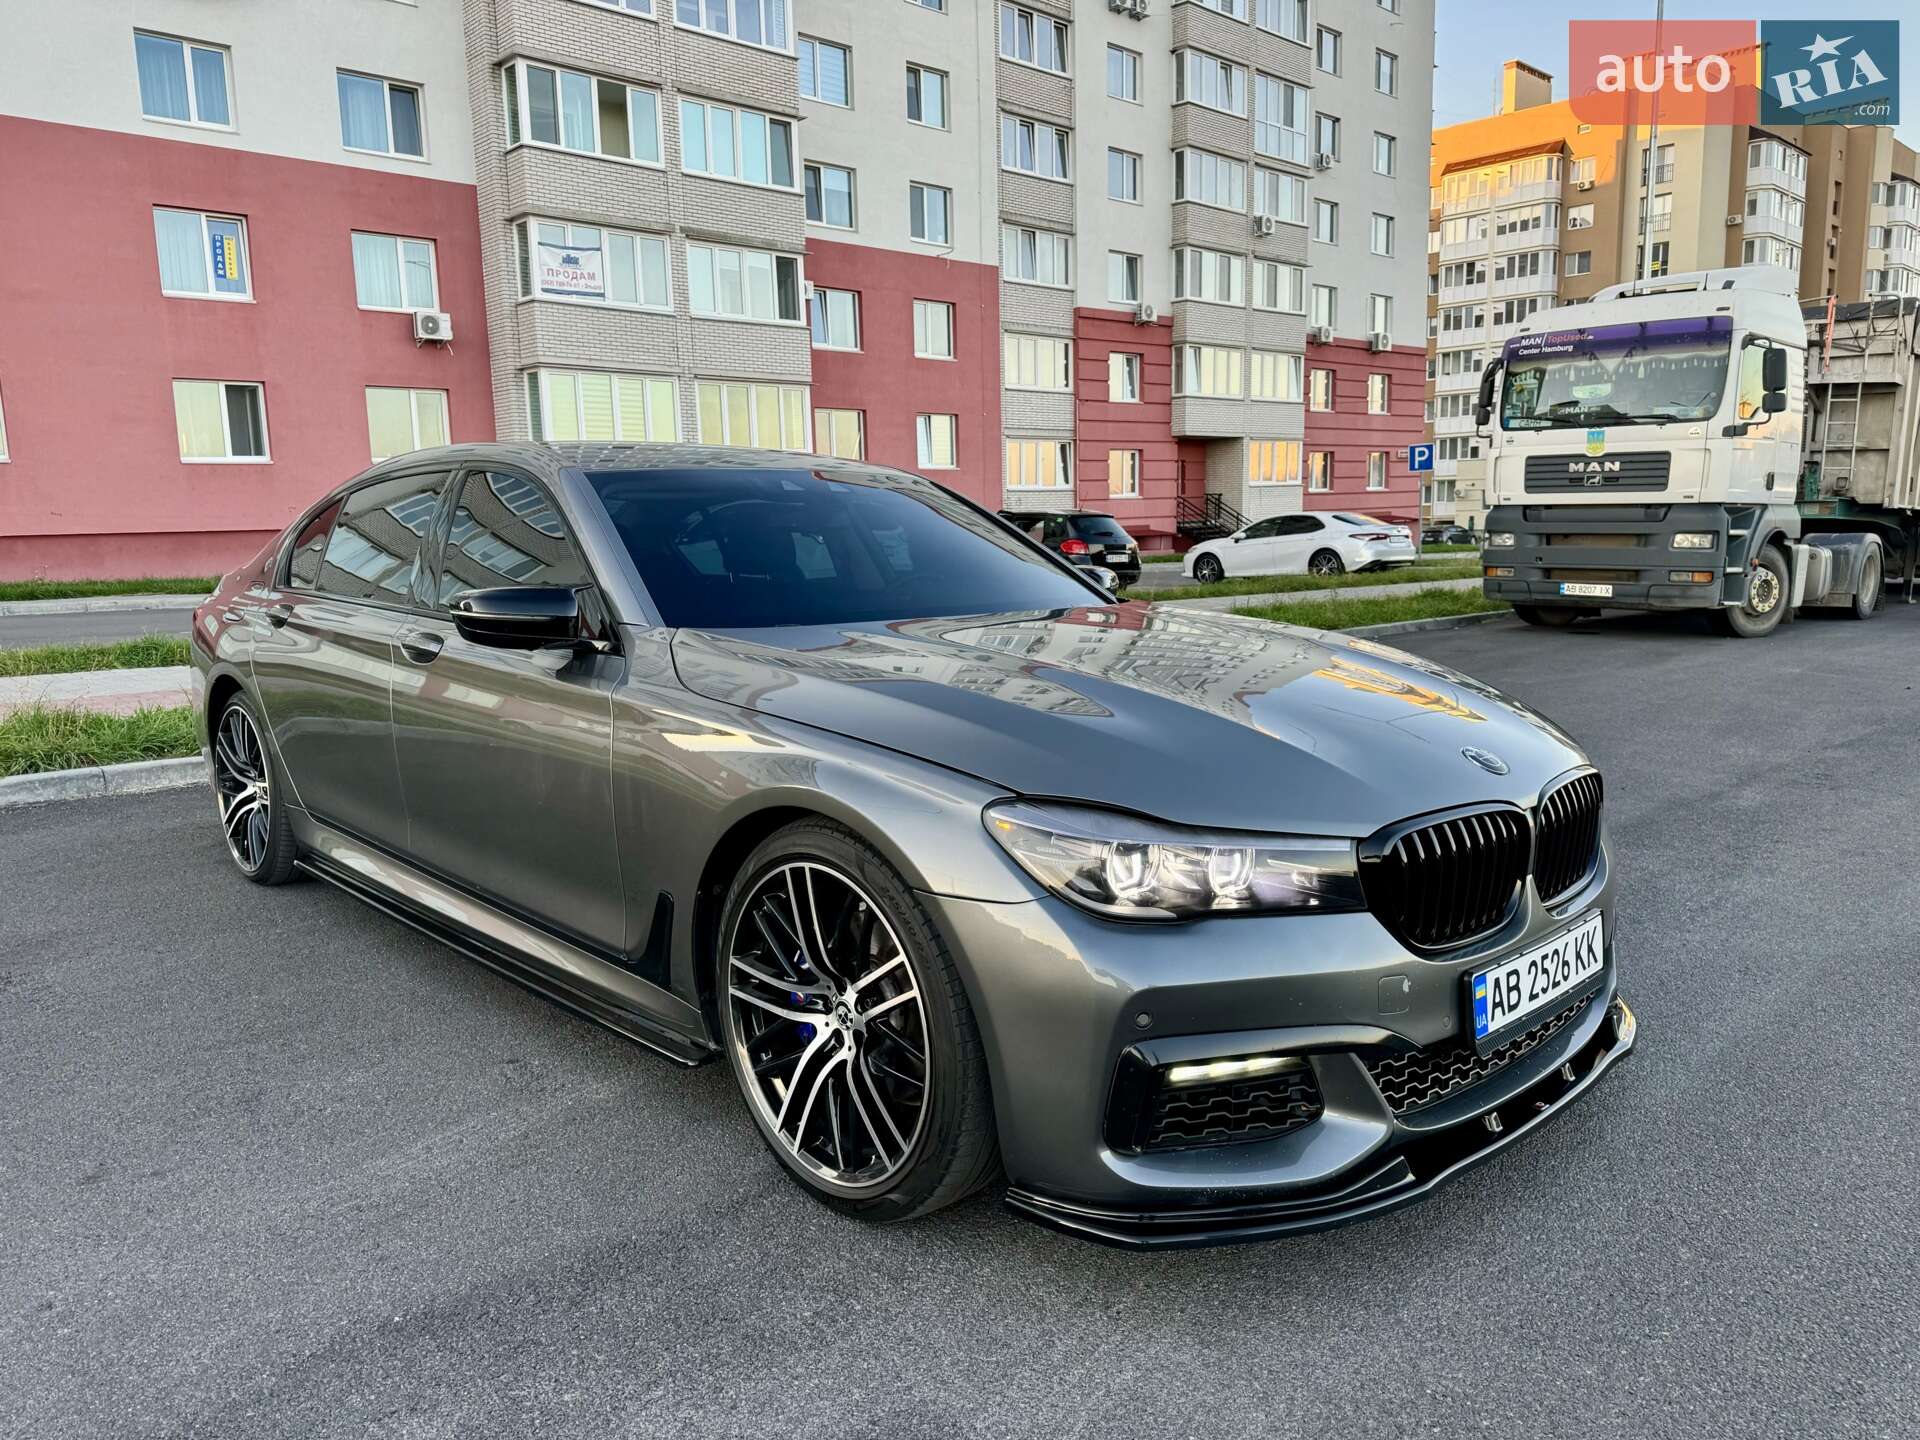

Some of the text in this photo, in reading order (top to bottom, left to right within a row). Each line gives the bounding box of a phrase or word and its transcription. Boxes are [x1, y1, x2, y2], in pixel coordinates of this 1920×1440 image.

[547, 268, 596, 281] ПРОДАМ
[1518, 344, 1574, 356] Center Hamburg
[1414, 446, 1429, 469] P
[1568, 461, 1621, 473] MAN
[1491, 926, 1598, 1022] AB 2526 KK
[1476, 1012, 1487, 1029] UA
